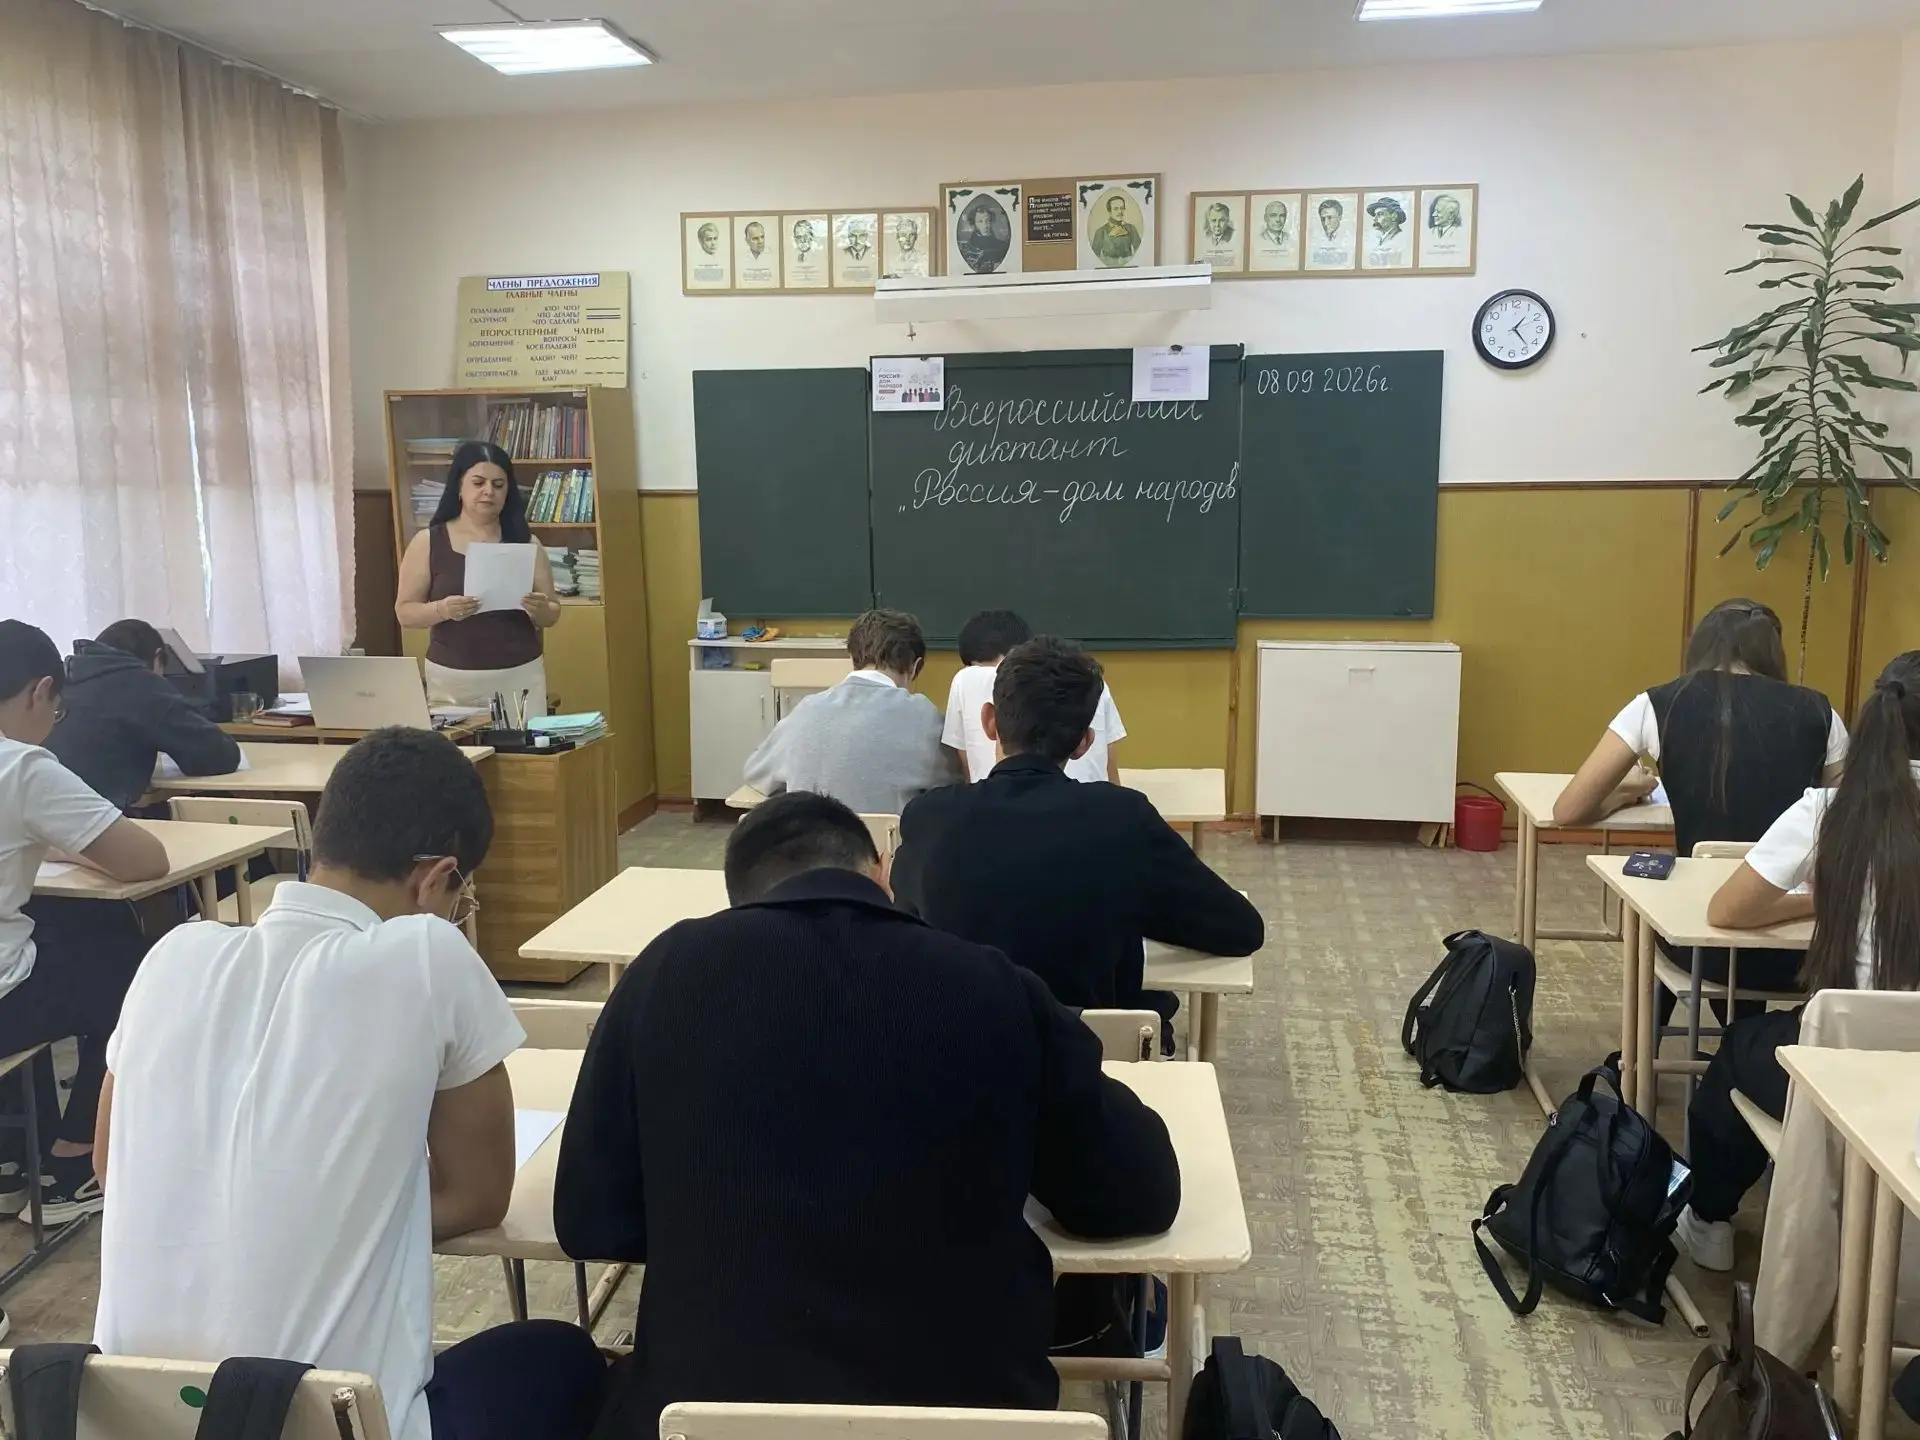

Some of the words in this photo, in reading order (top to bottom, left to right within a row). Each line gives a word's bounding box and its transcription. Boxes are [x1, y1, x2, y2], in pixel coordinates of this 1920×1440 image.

[489, 280, 522, 289] ЧЛЕНЫ
[526, 277, 598, 288] ПРЕДЛОЖЕНИЯ
[506, 291, 543, 299] ГЛАВНЫЕ
[547, 290, 578, 298] ЧЛЕНЫ
[1500, 303, 1508, 312] 11
[1511, 299, 1522, 309] 12
[1489, 311, 1500, 321] 10
[1533, 312, 1541, 321] 2
[480, 328, 558, 337] ВТОРОСТЕПЕННЫЕ
[573, 327, 605, 335] ЧЛЕНЫ
[1485, 324, 1493, 333] 9
[1536, 325, 1544, 334] 3
[1488, 336, 1496, 345] 8
[1531, 338, 1538, 346] 4
[1497, 346, 1504, 354] 7
[1508, 349, 1516, 358] 6
[1521, 346, 1529, 355] 5
[948, 436, 1130, 488] диктант
